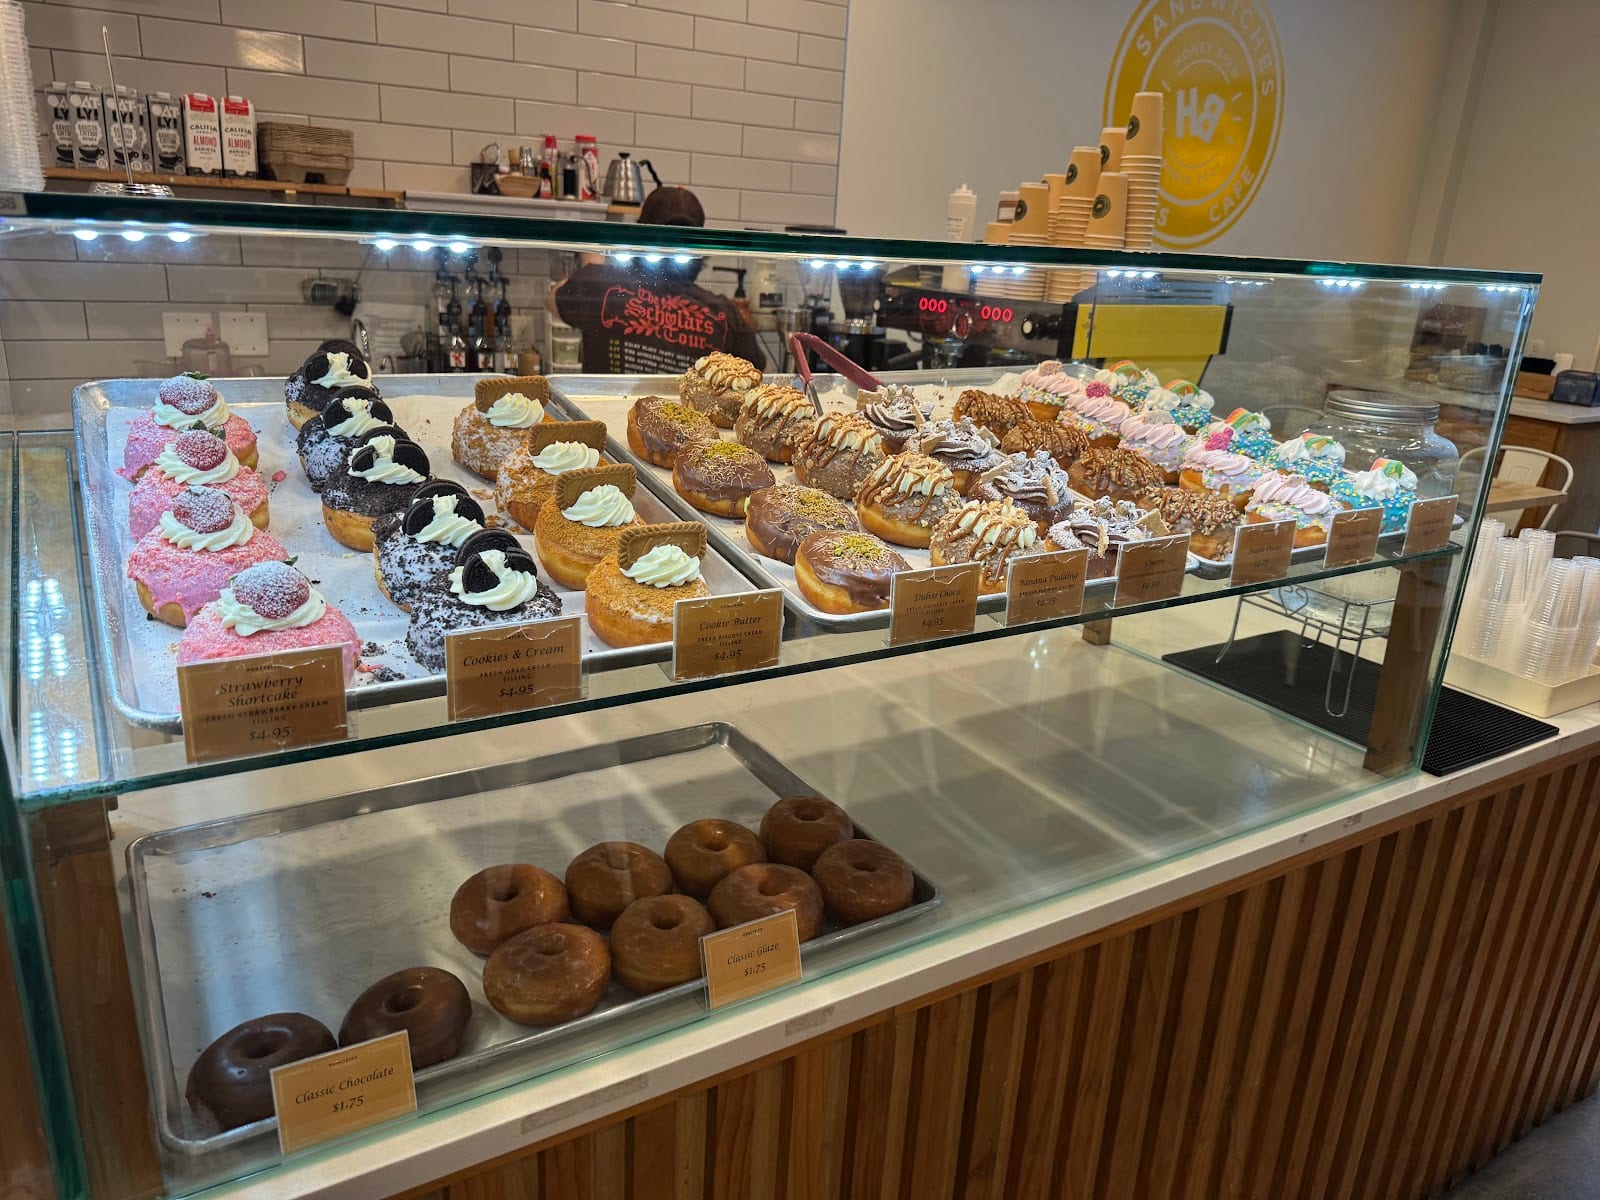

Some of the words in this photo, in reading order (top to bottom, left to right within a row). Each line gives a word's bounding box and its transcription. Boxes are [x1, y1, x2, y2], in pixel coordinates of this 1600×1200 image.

[193, 135, 217, 148] ALMOND
[228, 138, 252, 150] ALMOND
[1209, 167, 1254, 222] CAFE
[637, 288, 659, 305] The
[919, 297, 948, 313] 000
[981, 306, 1013, 322] 000
[663, 325, 707, 349] Tour
[1019, 577, 1048, 587] Banana
[699, 619, 731, 632] Cookie
[733, 616, 763, 628] Butter
[463, 652, 508, 667] Cookies
[512, 649, 522, 660] &
[525, 643, 565, 658] Cream
[713, 649, 742, 661] $4.95
[480, 670, 503, 679] FRESH
[219, 674, 304, 695] Strawberry
[498, 684, 534, 698] $4.95
[227, 687, 299, 708] Shortcake
[299, 700, 329, 710] CREAM
[249, 726, 291, 741] $4.95
[727, 950, 756, 965] Classic
[756, 942, 779, 956] Glaze
[744, 962, 766, 976] $1.75
[295, 1086, 335, 1105] Classic
[338, 1066, 394, 1091] Chocolate
[332, 1095, 364, 1113] $1.75
